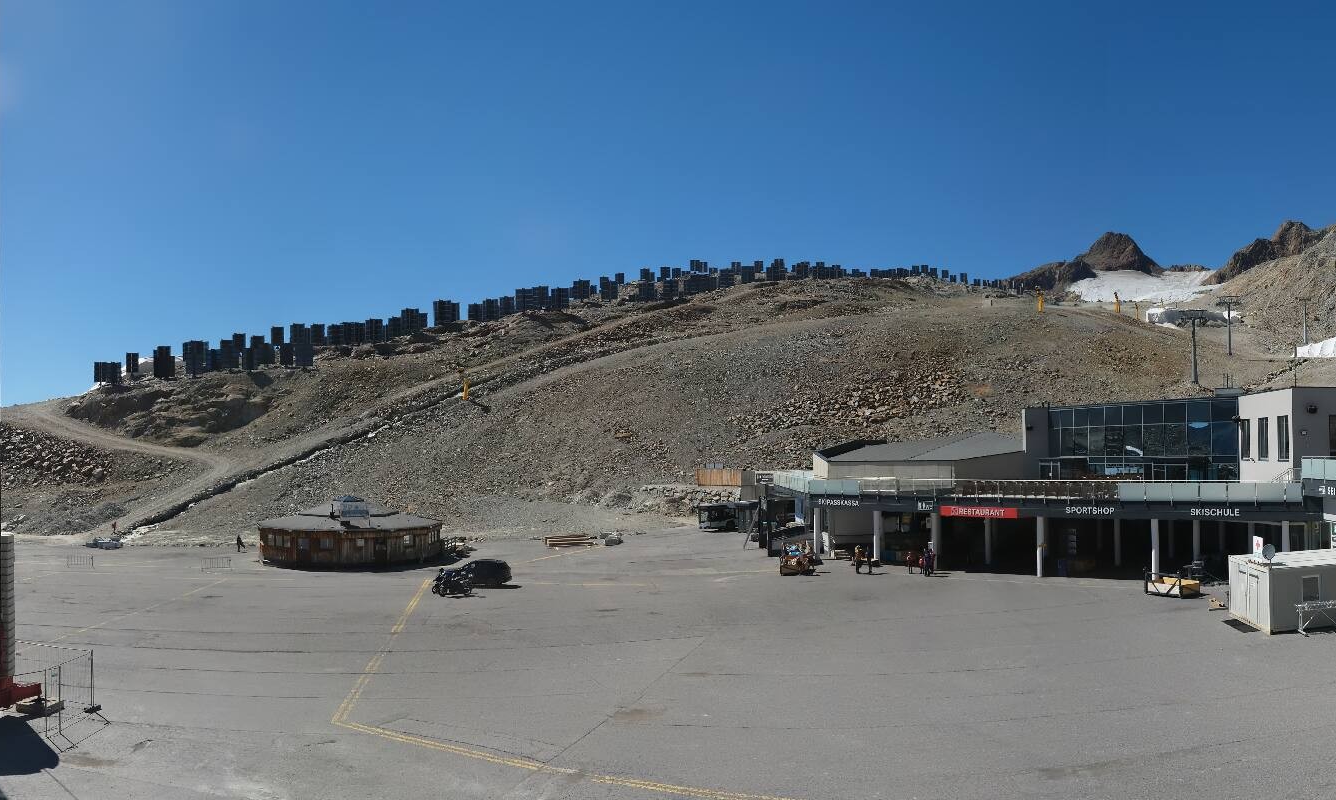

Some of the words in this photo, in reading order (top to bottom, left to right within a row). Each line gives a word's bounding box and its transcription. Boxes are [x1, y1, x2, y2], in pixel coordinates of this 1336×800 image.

[818, 498, 860, 507] SKIPASSKASSA
[958, 507, 1005, 516] RESTAURANT
[1065, 506, 1115, 515] SPORTSHOP
[1190, 508, 1240, 517] SKISCHULE
